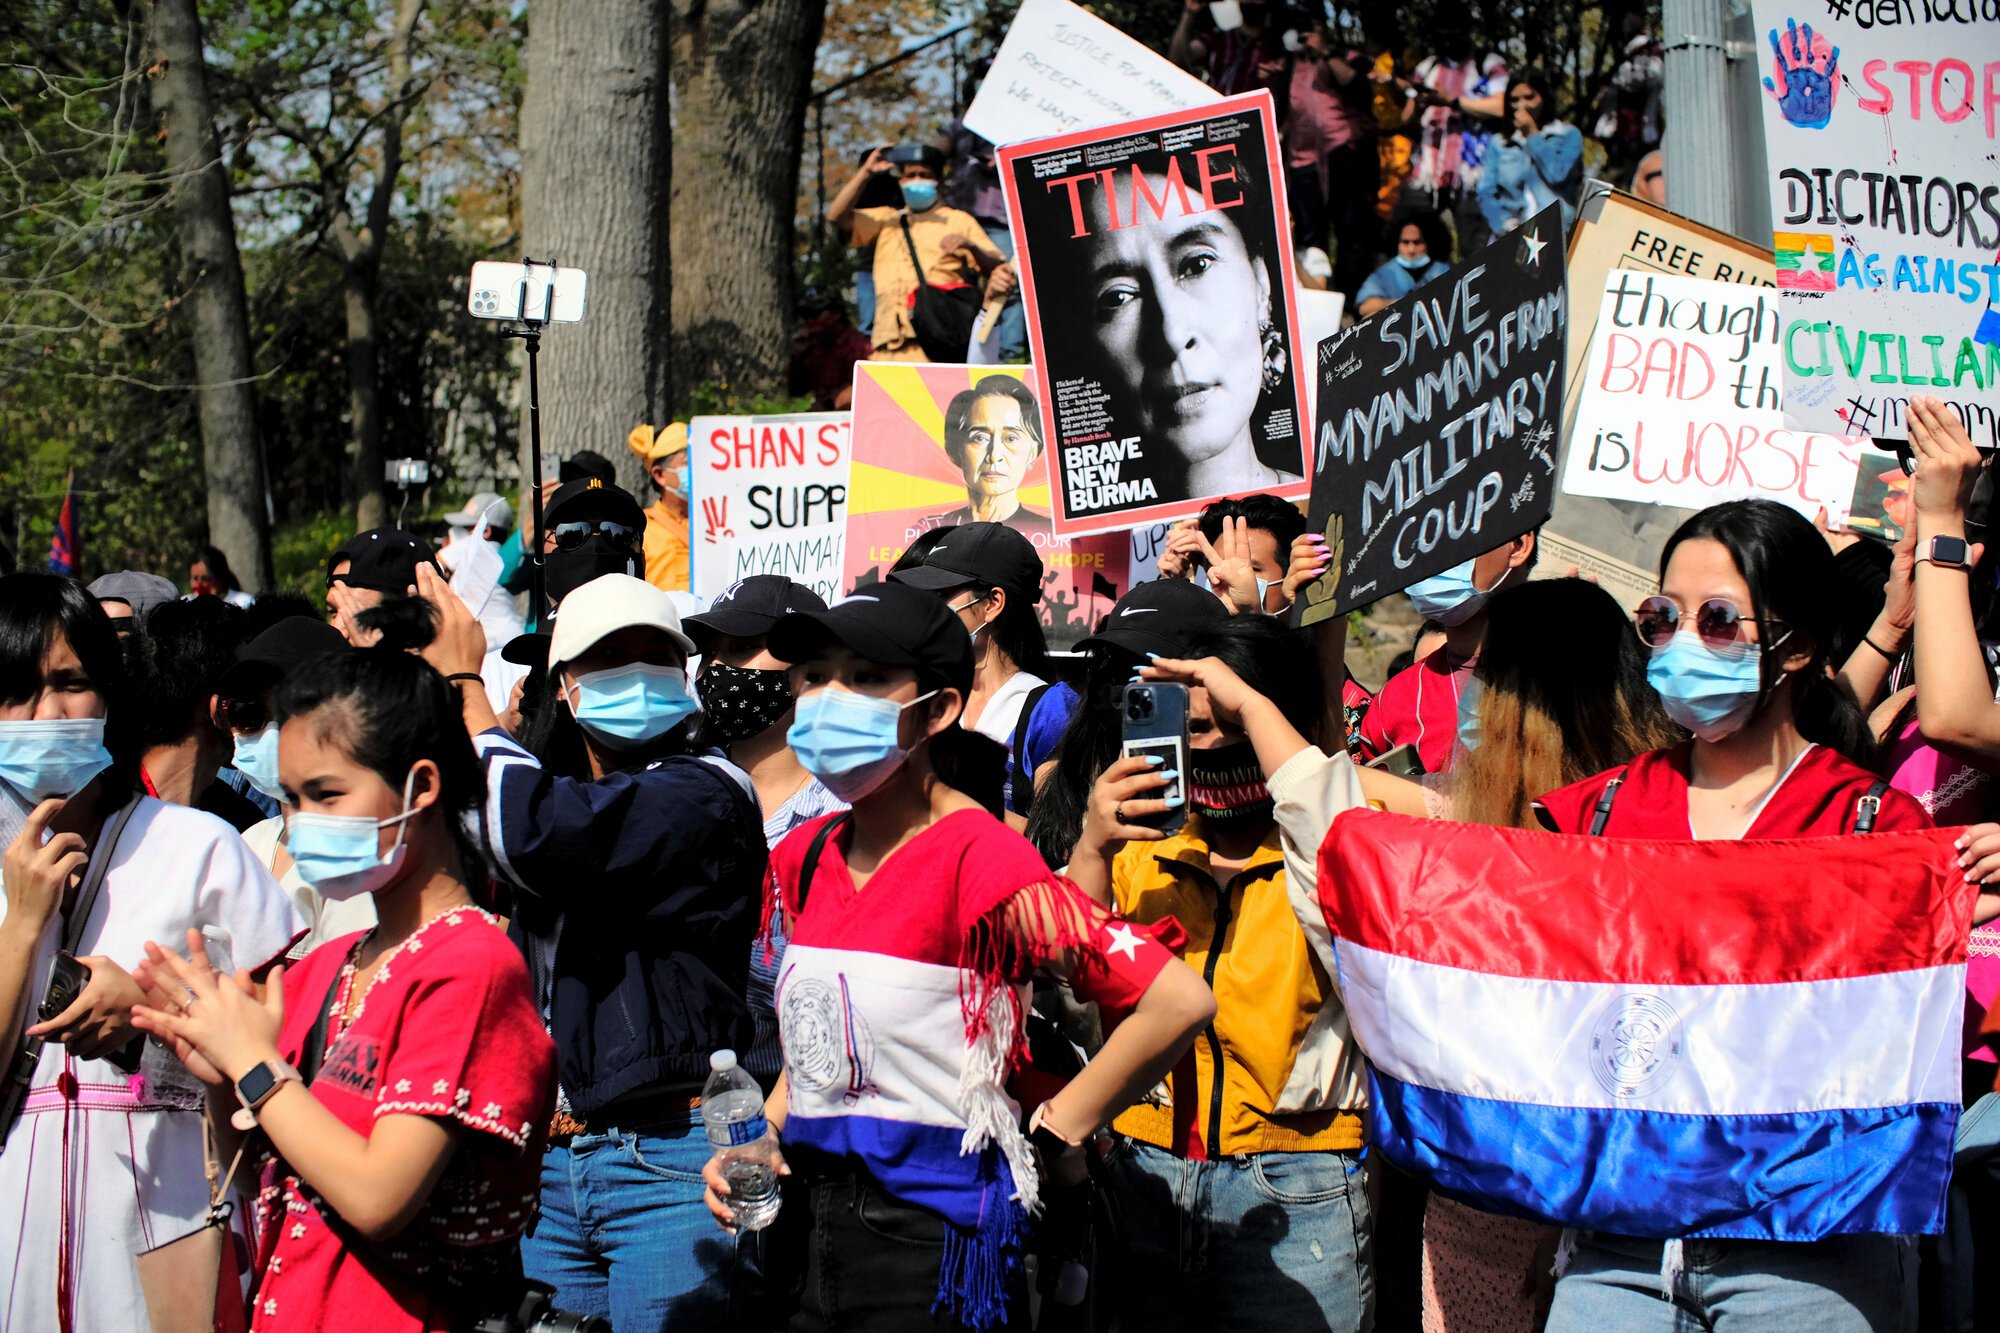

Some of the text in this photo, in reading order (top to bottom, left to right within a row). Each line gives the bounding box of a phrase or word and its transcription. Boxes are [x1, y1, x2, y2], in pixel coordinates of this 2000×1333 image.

[1048, 23, 1114, 66] JUSTICE
[1037, 97, 1083, 126] WANT
[1046, 143, 1244, 239] TIME
[1779, 168, 2000, 250] DICTATORS
[1630, 230, 1704, 276] FREE
[1837, 247, 2000, 304] AGAINST
[1379, 263, 1491, 377] SAVE
[1606, 274, 1780, 362] though
[1315, 329, 1500, 474] MYANMAR
[1499, 284, 1567, 370] FROM
[1600, 333, 1716, 401] BAD
[1730, 365, 1784, 412] th
[710, 422, 850, 470] SHAN S
[1064, 436, 1144, 470] BRAVE
[1362, 360, 1557, 536] MILITARY
[1588, 427, 1631, 472] is
[1632, 421, 1826, 503] WORSE
[1066, 461, 1121, 491] NEW
[1069, 477, 1159, 512] BURMA
[748, 484, 846, 529] SUPP
[1392, 470, 1504, 570] COUP
[1049, 552, 1105, 569] HOPE
[1132, 521, 1172, 563] UP
[1190, 782, 1269, 807] MYANMA
[1192, 767, 1229, 786] STAND
